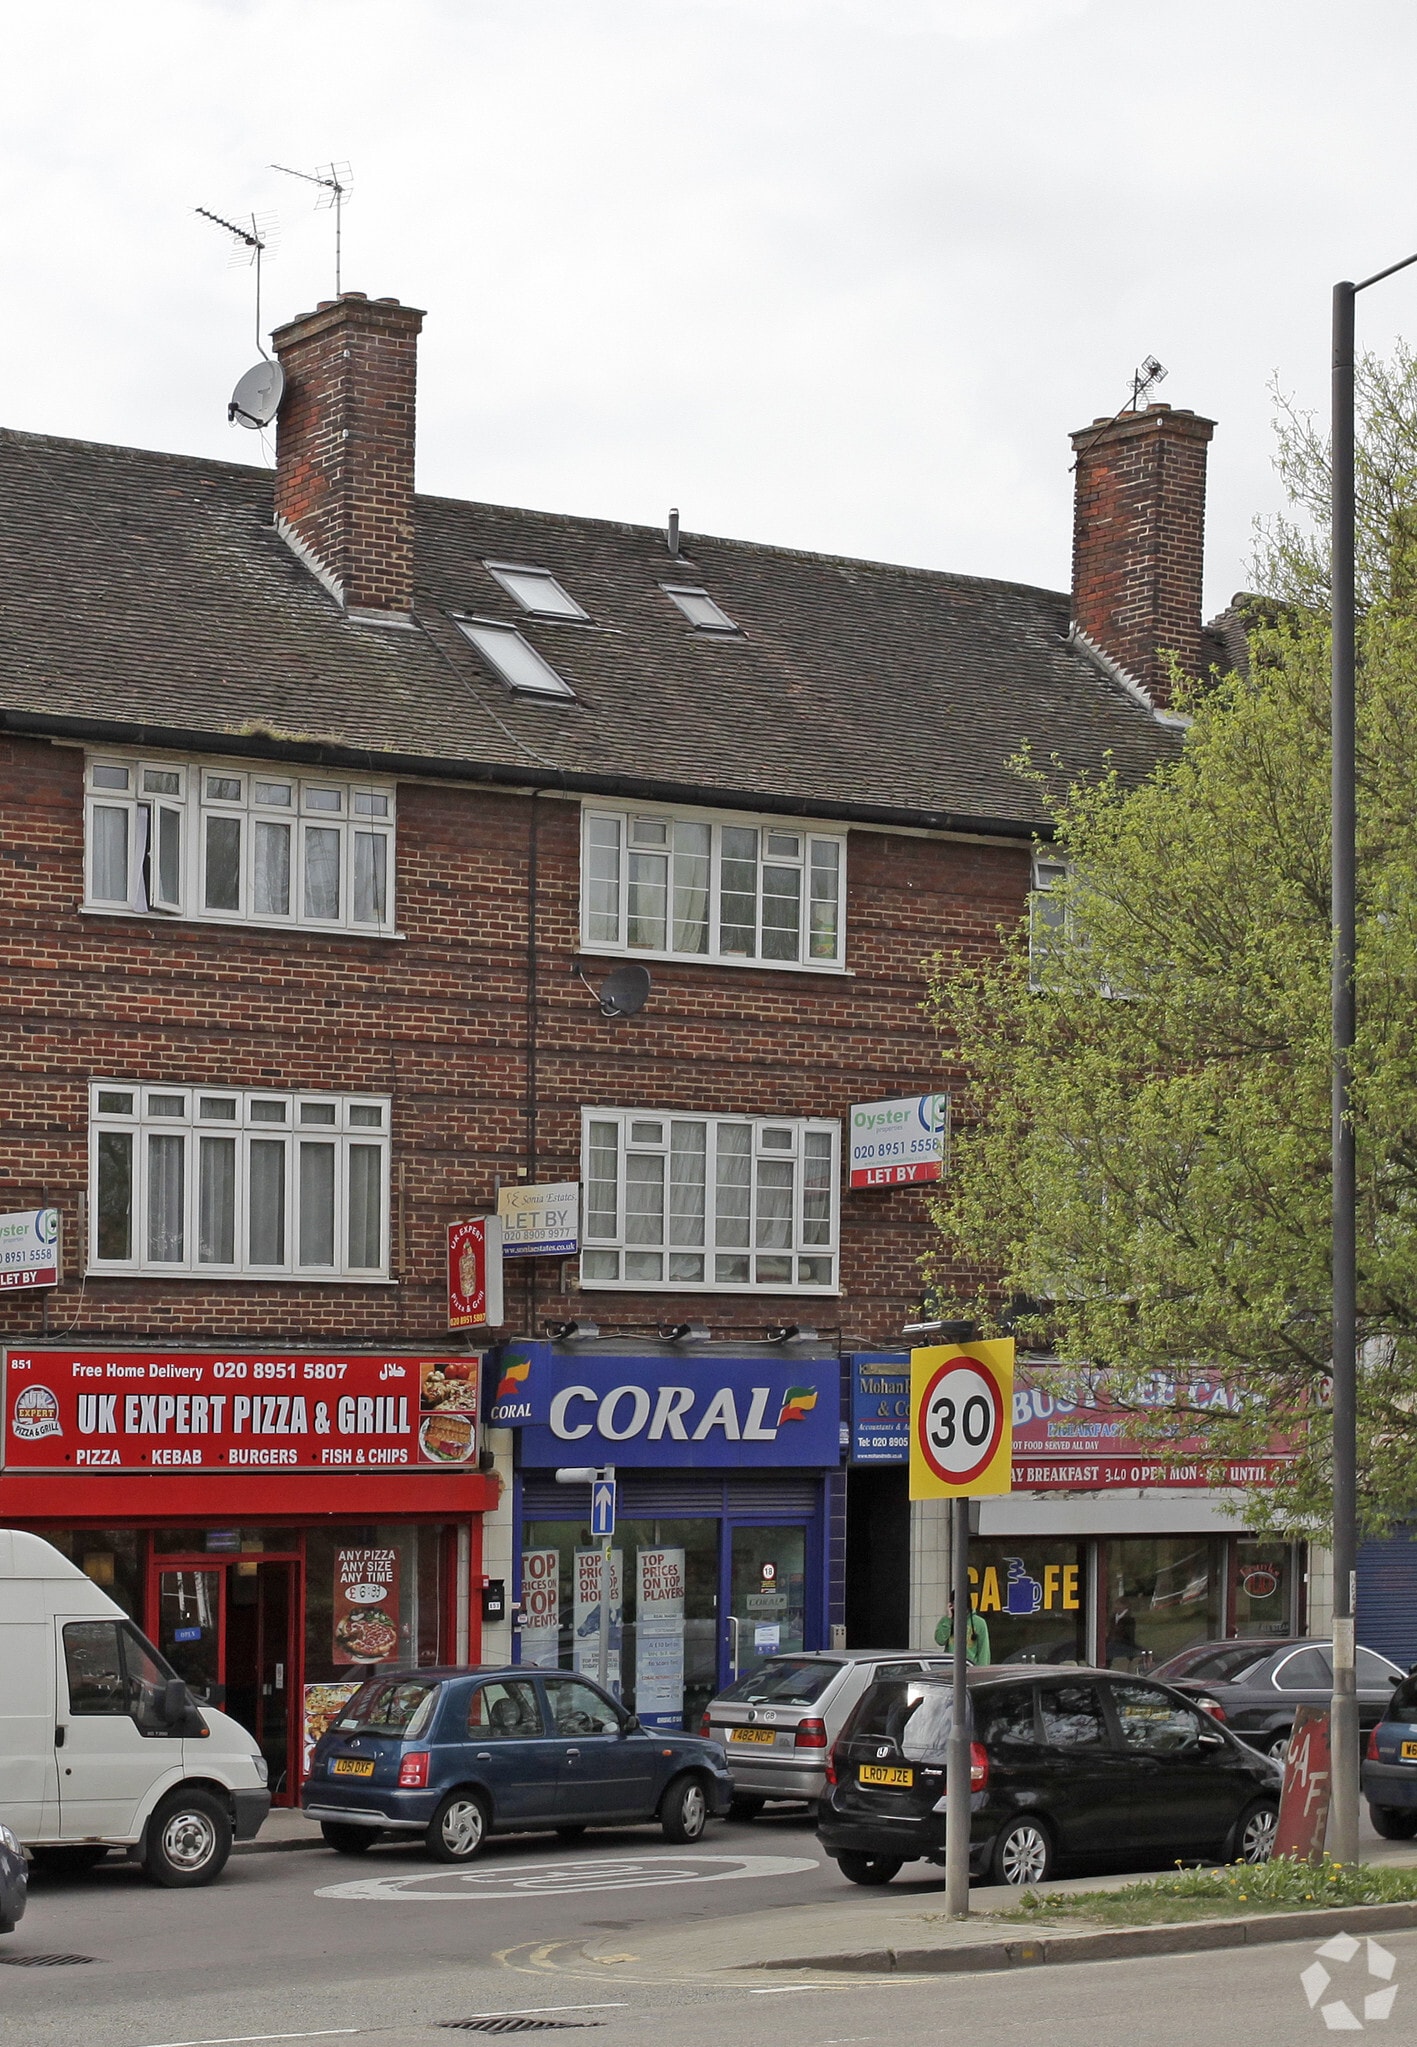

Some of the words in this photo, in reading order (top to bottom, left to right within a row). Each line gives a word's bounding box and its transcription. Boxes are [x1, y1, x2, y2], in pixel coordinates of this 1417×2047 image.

[854, 1109, 911, 1130] Oyster
[854, 1145, 875, 1160] 020
[878, 1142, 905, 1156] 8951
[910, 1138, 939, 1153] 5558
[867, 1168, 892, 1184] LET
[896, 1166, 918, 1181] BY
[505, 1212, 540, 1230] LET
[545, 1210, 568, 1227] BY
[0, 1224, 29, 1237] ster
[450, 1236, 460, 1250] UK
[460, 1225, 484, 1242] EXPERT
[504, 1232, 521, 1241] 020
[523, 1230, 546, 1240] 8909
[548, 1228, 570, 1238] 9977
[5, 1250, 26, 1264] 8951
[30, 1248, 52, 1261] 5558
[0, 1273, 20, 1286] LET
[23, 1271, 38, 1283] BY
[451, 1292, 466, 1312] Pizza
[472, 1290, 484, 1308] Grill
[11, 1360, 32, 1370] 851
[72, 1362, 102, 1378] Free
[106, 1363, 146, 1378] Home
[150, 1364, 204, 1382] Delivery
[213, 1362, 248, 1378] 020
[253, 1362, 296, 1379] 8951
[304, 1364, 348, 1380] 5807
[24, 1391, 50, 1408] UK
[19, 1410, 54, 1418] EXPERT
[77, 1394, 118, 1435] UK
[124, 1394, 227, 1434] EXPERT
[233, 1396, 308, 1434] PIZZA
[314, 1402, 331, 1435] &
[338, 1396, 411, 1434] GRILL
[490, 1402, 532, 1420] CORAL
[550, 1385, 778, 1441] CORAL
[878, 1400, 890, 1416] &
[930, 1394, 990, 1449] 30
[15, 1426, 36, 1438] PIZZA
[42, 1422, 60, 1436] GRILL
[858, 1437, 870, 1447] Tel:
[872, 1437, 888, 1447] 020
[888, 1436, 908, 1447] 8905
[1024, 1440, 1042, 1450] FOOD
[1045, 1440, 1070, 1450] SERVED
[1072, 1440, 1083, 1450] ALL
[1085, 1440, 1099, 1450] DAY
[76, 1449, 122, 1465] PIZZA
[152, 1449, 202, 1465] KEBAB
[228, 1448, 298, 1464] BURGERS
[322, 1448, 352, 1464] FISH
[355, 1449, 366, 1464] &
[368, 1448, 408, 1464] CHIPS
[1027, 1466, 1100, 1482] BREAKFAST
[1170, 1466, 1197, 1480] MON
[1230, 1466, 1266, 1481] UNTIL
[338, 1550, 362, 1561] ANY
[364, 1550, 396, 1561] PIZZA
[578, 1556, 602, 1567] TOP
[642, 1554, 664, 1566] TOP
[342, 1562, 364, 1572] ANY
[367, 1561, 392, 1572] SIZE
[580, 1565, 616, 1579] PRIS
[642, 1564, 678, 1578] PRICES
[765, 1568, 772, 1576] 18
[340, 1572, 363, 1583] ANY
[366, 1572, 393, 1582] TIME
[548, 1579, 557, 1590] ON
[580, 1578, 598, 1590] ON
[643, 1578, 661, 1590] ON
[664, 1577, 680, 1588] TOP
[350, 1588, 356, 1599] £
[581, 1588, 619, 1602] HOES
[644, 1587, 684, 1602] PLAYERS
[733, 1729, 754, 1740] T482
[755, 1730, 774, 1740] NCF
[354, 1762, 372, 1774] DXF
[864, 1766, 888, 1780] LR07
[890, 1770, 909, 1783] JZE
